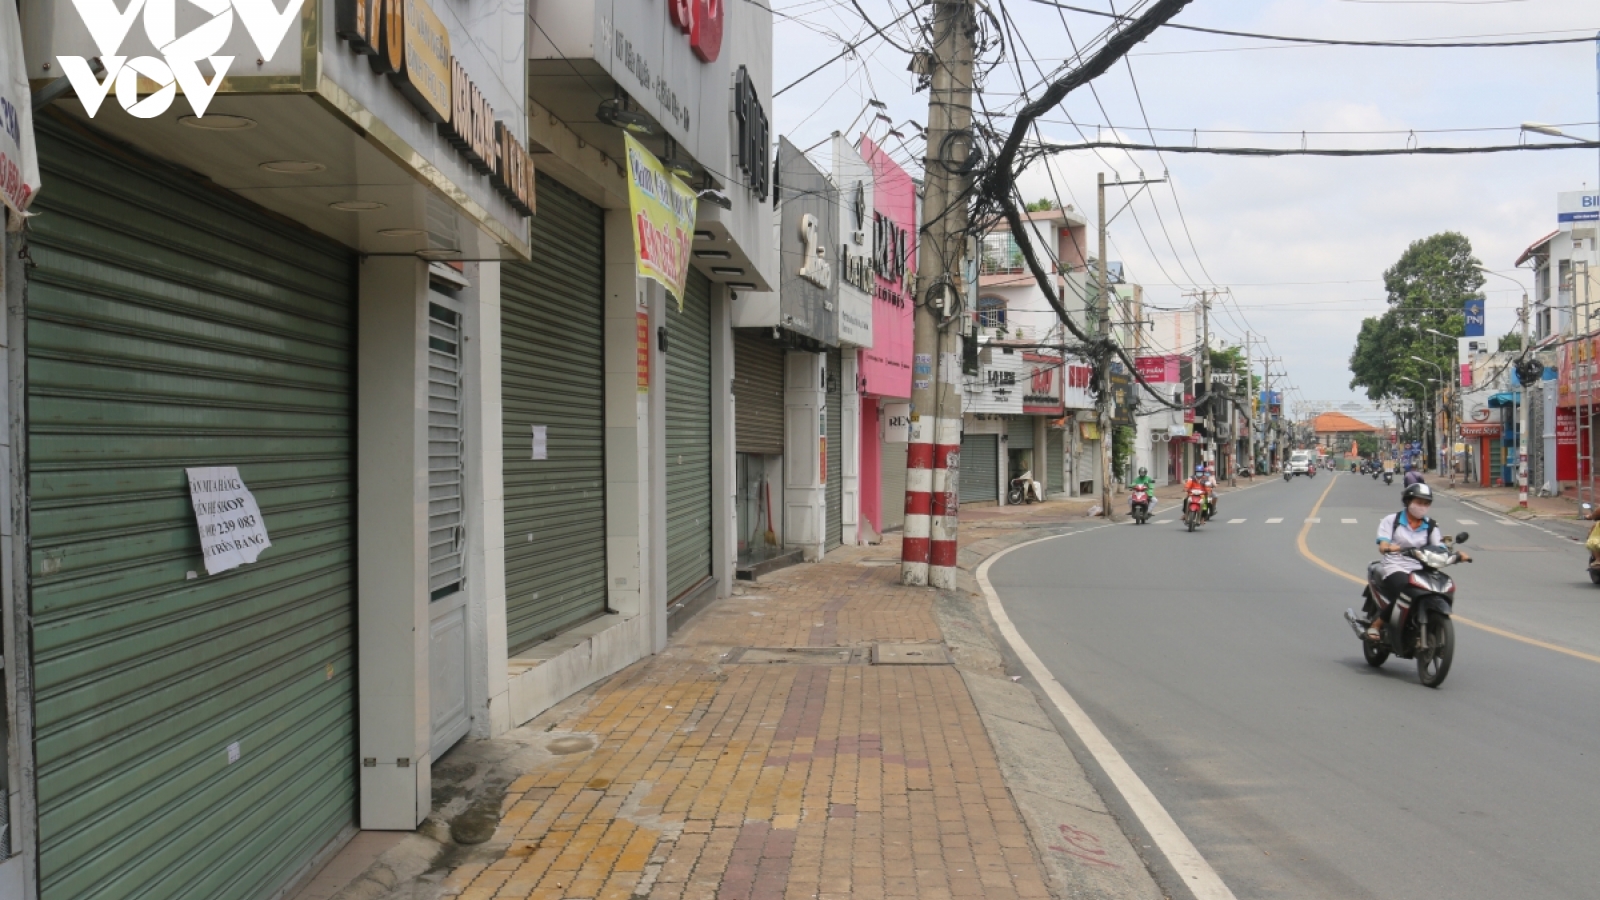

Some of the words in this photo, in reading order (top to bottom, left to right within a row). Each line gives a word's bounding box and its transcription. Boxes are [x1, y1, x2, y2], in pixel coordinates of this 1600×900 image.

[1582, 195, 1599, 207] BI
[1466, 315, 1483, 325] PNJ
[1483, 427, 1499, 435] Style
[217, 519, 235, 534] 239
